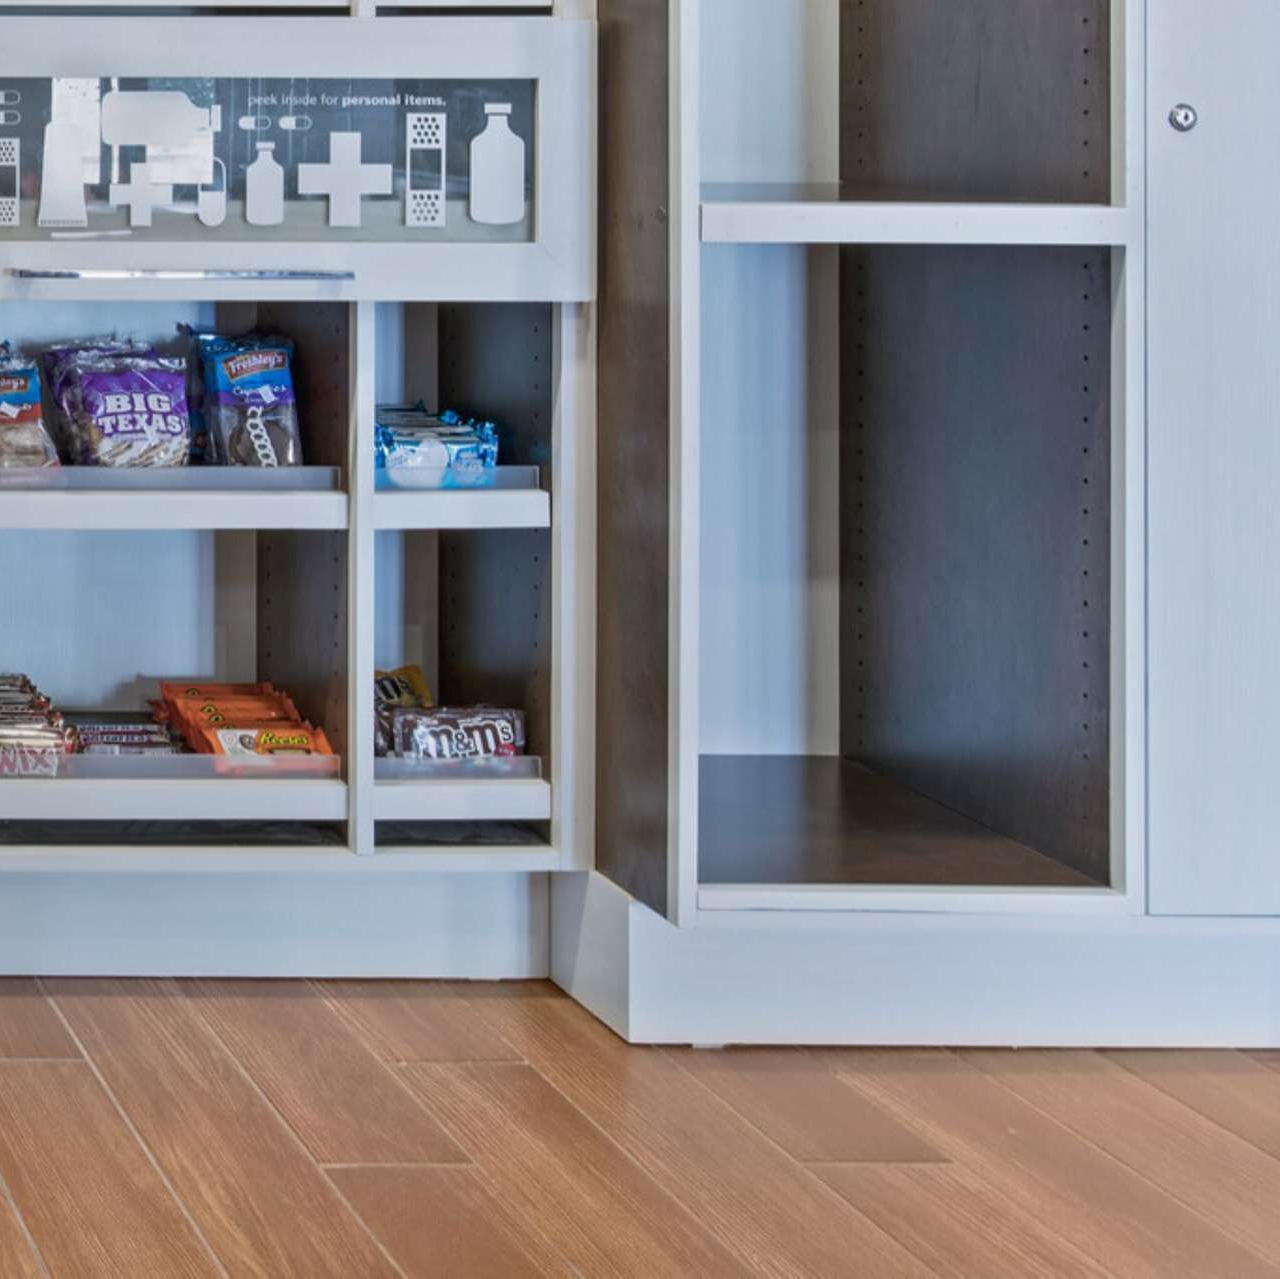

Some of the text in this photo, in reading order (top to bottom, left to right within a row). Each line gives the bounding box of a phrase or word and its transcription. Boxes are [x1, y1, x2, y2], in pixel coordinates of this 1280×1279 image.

[248, 93, 447, 107] peek inside for personal items.
[105, 392, 172, 414] BIG
[97, 413, 185, 436] TEXAS
